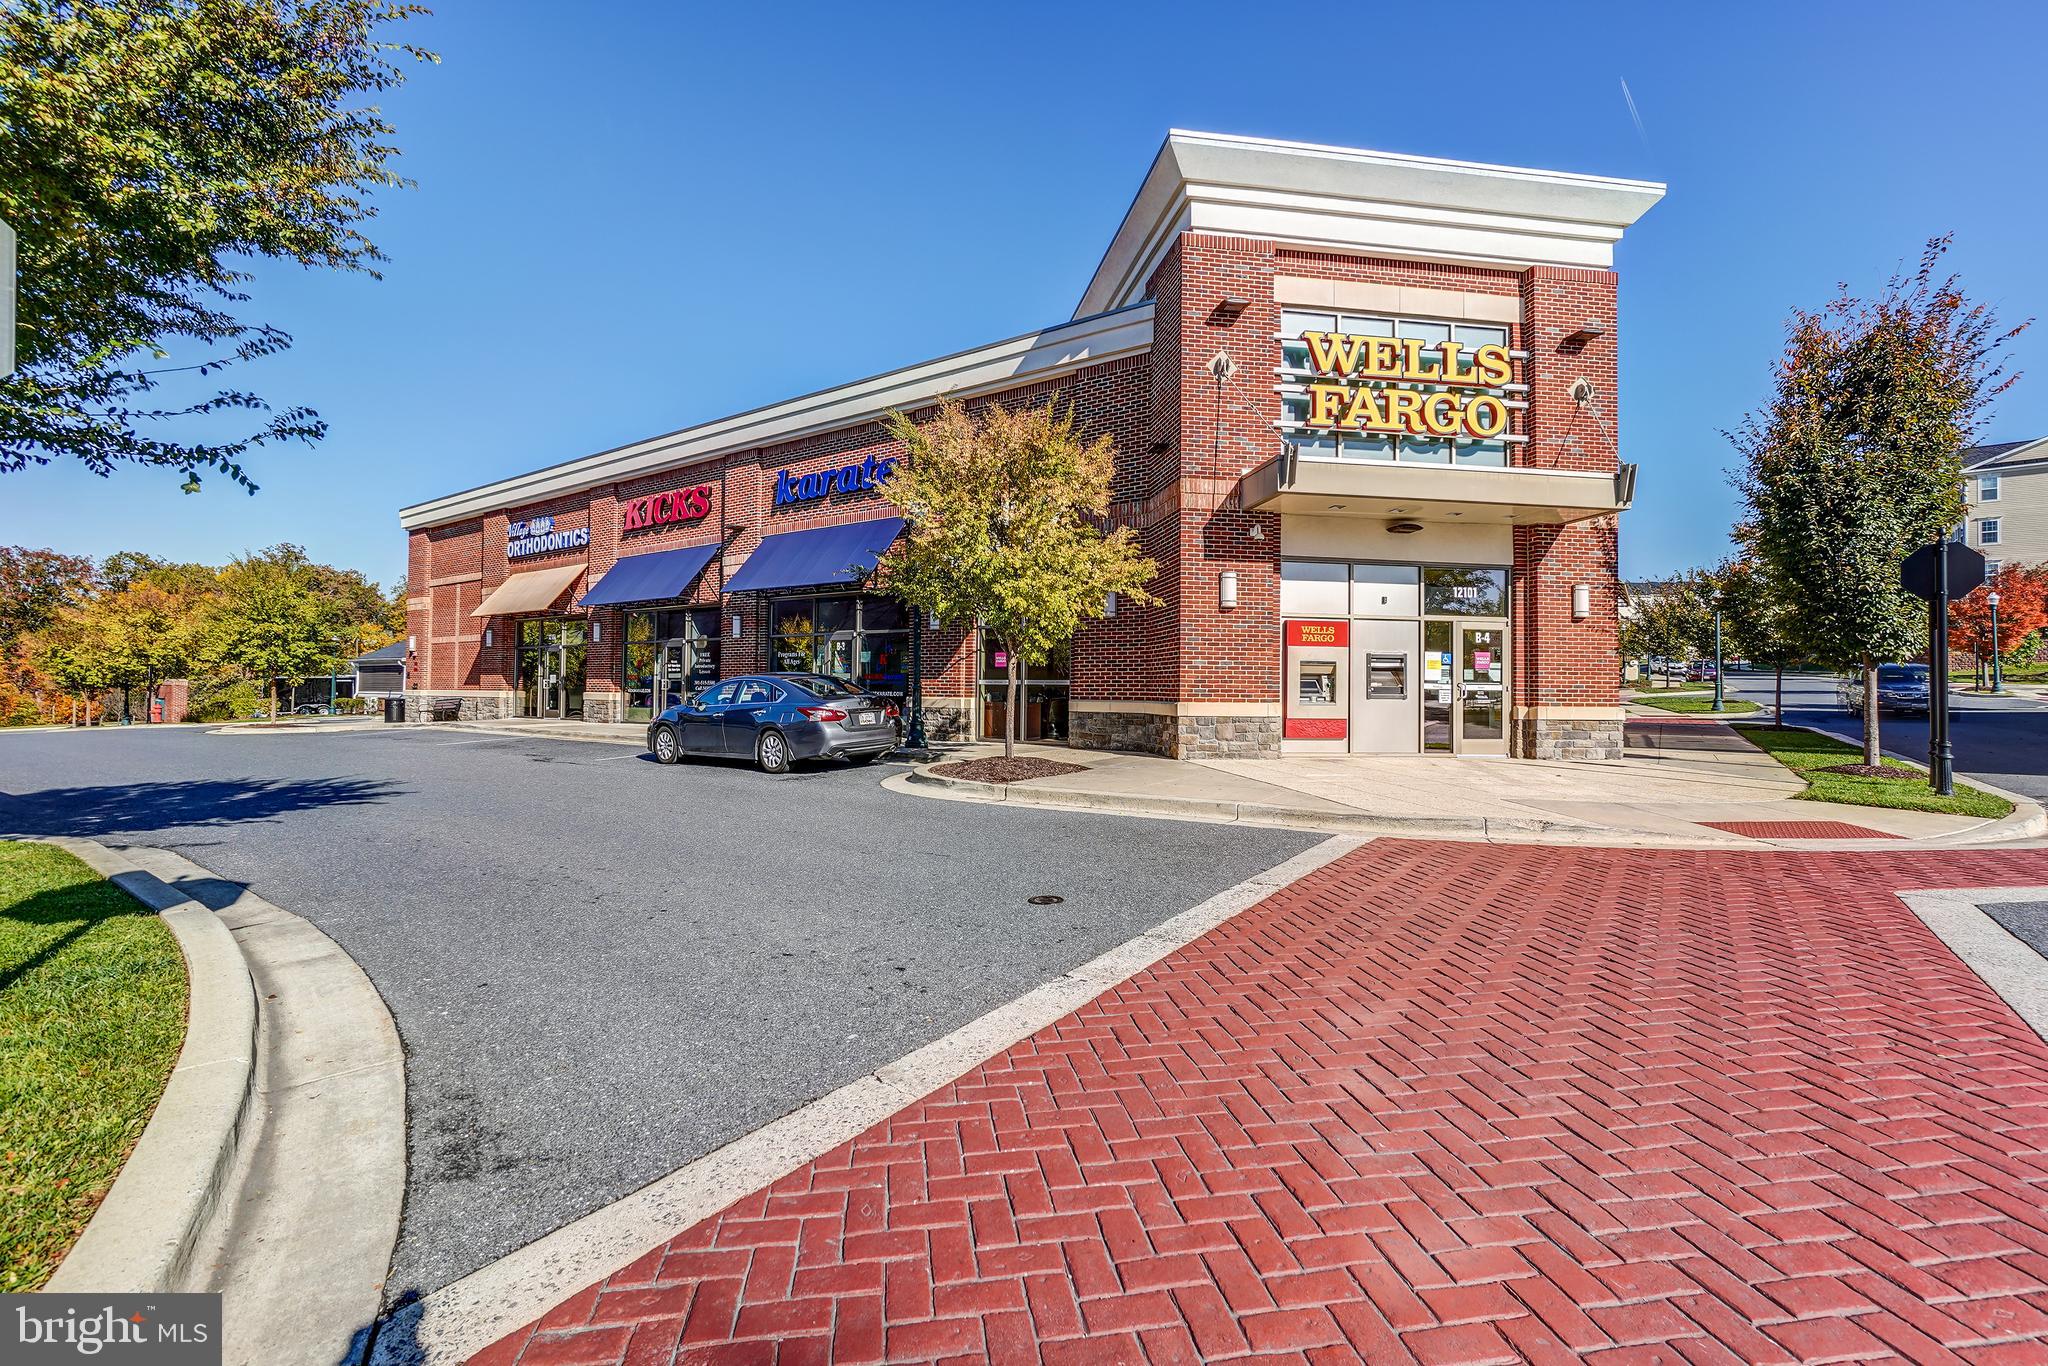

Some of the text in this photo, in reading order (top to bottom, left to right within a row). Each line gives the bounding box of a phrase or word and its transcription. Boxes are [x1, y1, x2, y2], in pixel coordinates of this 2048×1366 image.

[1300, 331, 1513, 388] WELLS
[1306, 383, 1508, 438] FARGO
[776, 454, 898, 506] karate
[623, 485, 713, 532] KICKS
[507, 528, 589, 558] ORTHODONTICS
[1453, 586, 1478, 598] 12101
[1301, 626, 1335, 634] WELLS
[1301, 634, 1335, 643] FARGO
[1475, 632, 1491, 643] B-4
[836, 641, 846, 651] B-3
